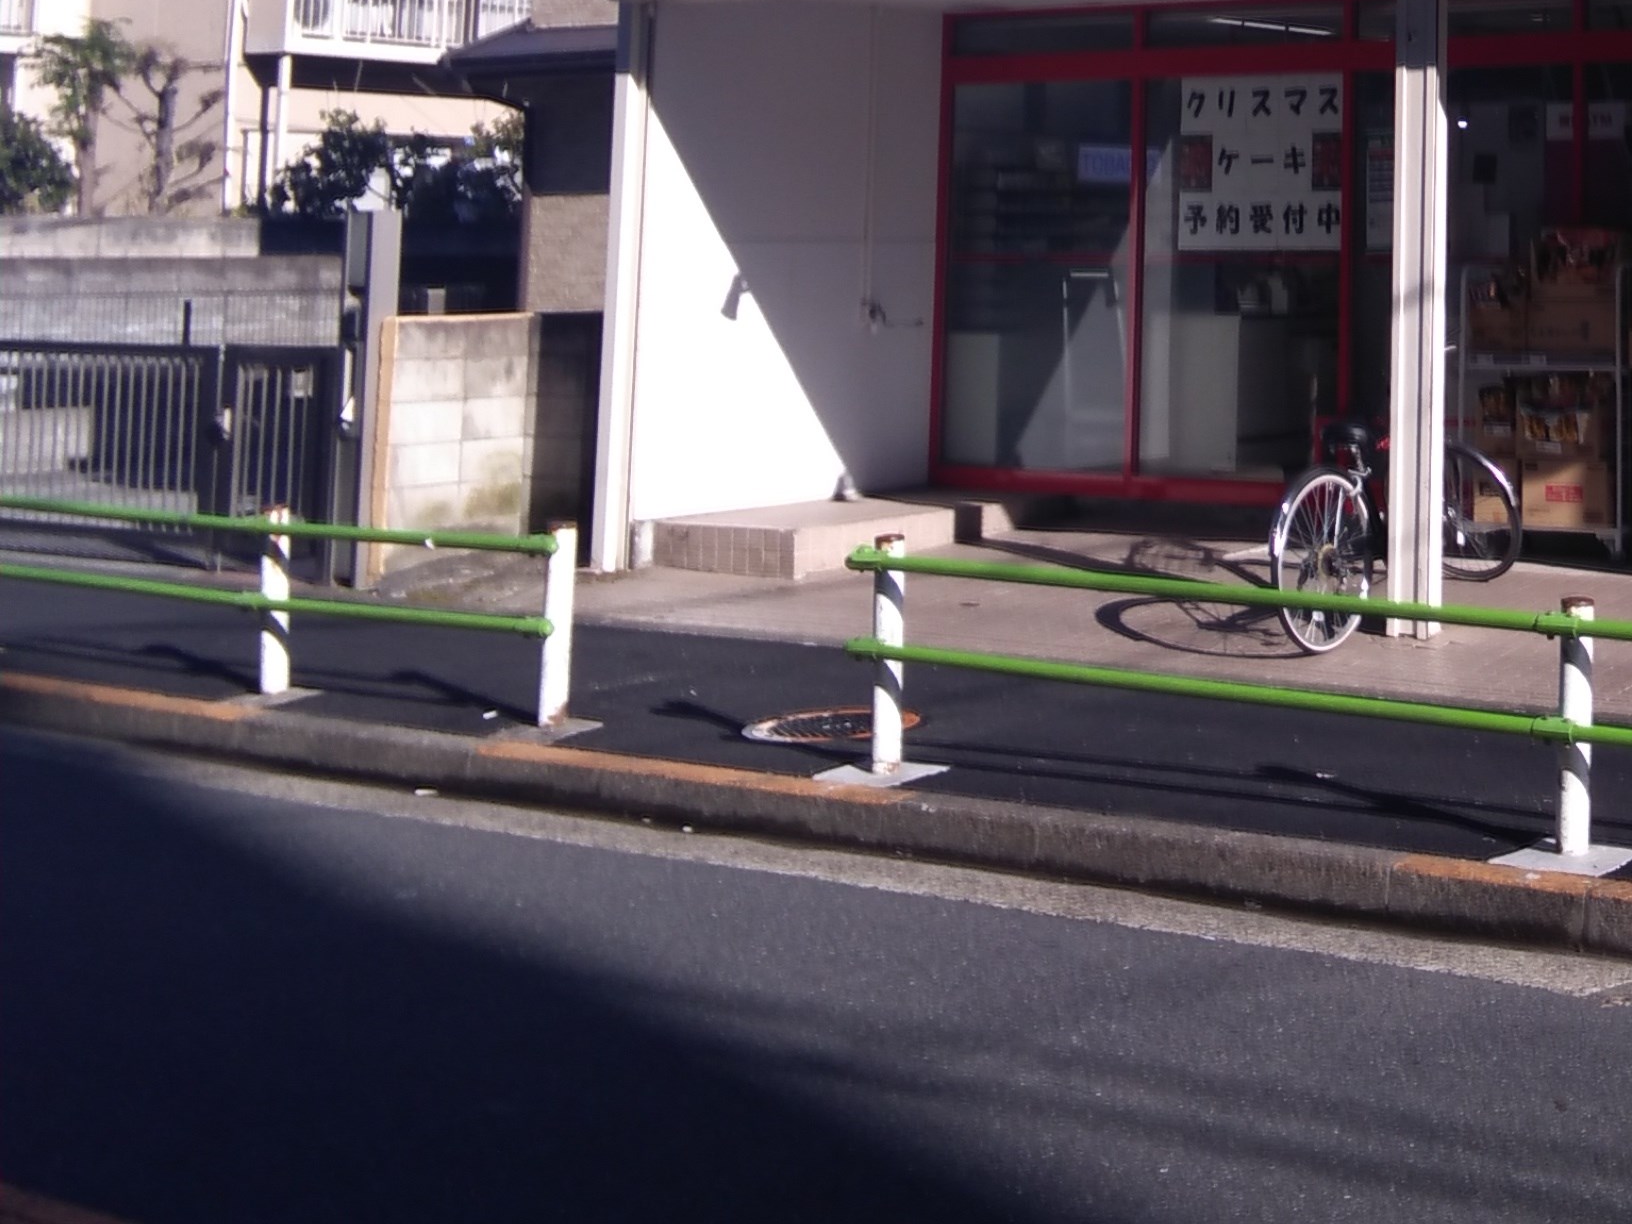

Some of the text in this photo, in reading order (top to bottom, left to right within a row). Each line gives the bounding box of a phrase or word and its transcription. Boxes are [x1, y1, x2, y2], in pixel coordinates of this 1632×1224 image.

[1186, 86, 1339, 118] クリスマス
[1217, 142, 1306, 175] ケーキ
[1183, 202, 1340, 235] 予約受付中
